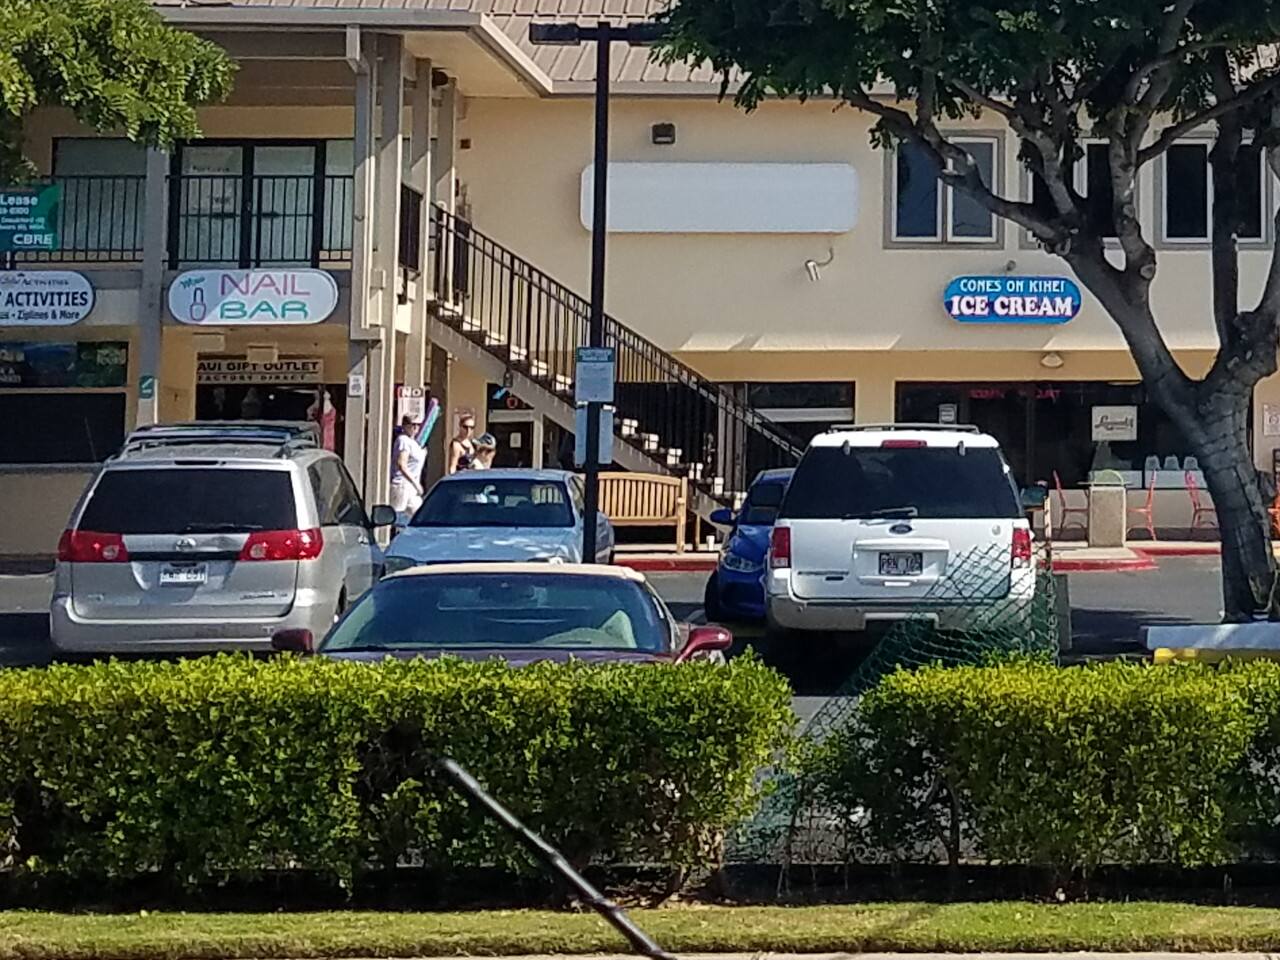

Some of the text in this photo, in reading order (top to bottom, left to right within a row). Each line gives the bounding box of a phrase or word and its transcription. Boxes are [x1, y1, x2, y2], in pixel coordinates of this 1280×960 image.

[0, 194, 39, 206] Lease
[13, 233, 54, 245] CBRE
[219, 273, 312, 296] NAIL
[959, 279, 1066, 293] CONES ON KIHEI
[4, 290, 89, 307] ACTIVITIES
[950, 295, 1073, 316] ICE CREAM
[219, 300, 309, 320] BAR
[198, 361, 222, 372] AUI
[263, 361, 320, 372] OUTLET
